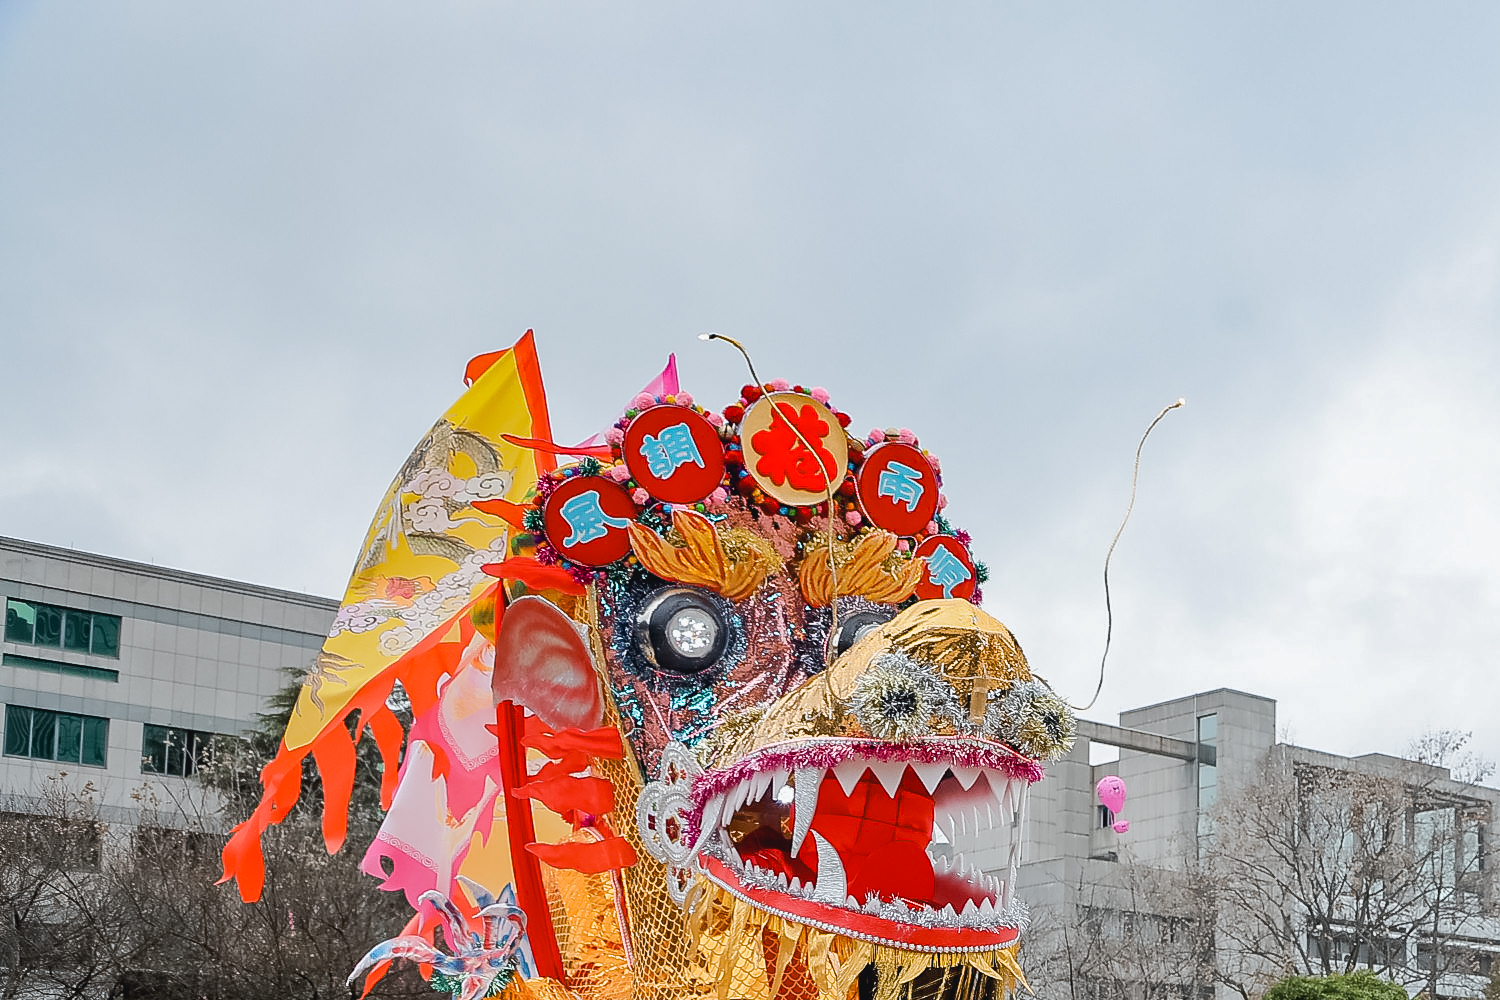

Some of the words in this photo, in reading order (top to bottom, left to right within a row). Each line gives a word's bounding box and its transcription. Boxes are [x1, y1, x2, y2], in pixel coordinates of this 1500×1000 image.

[639, 422, 706, 480] 調
[877, 460, 925, 513] 雨
[559, 489, 630, 549] 風
[923, 543, 972, 599] 順
